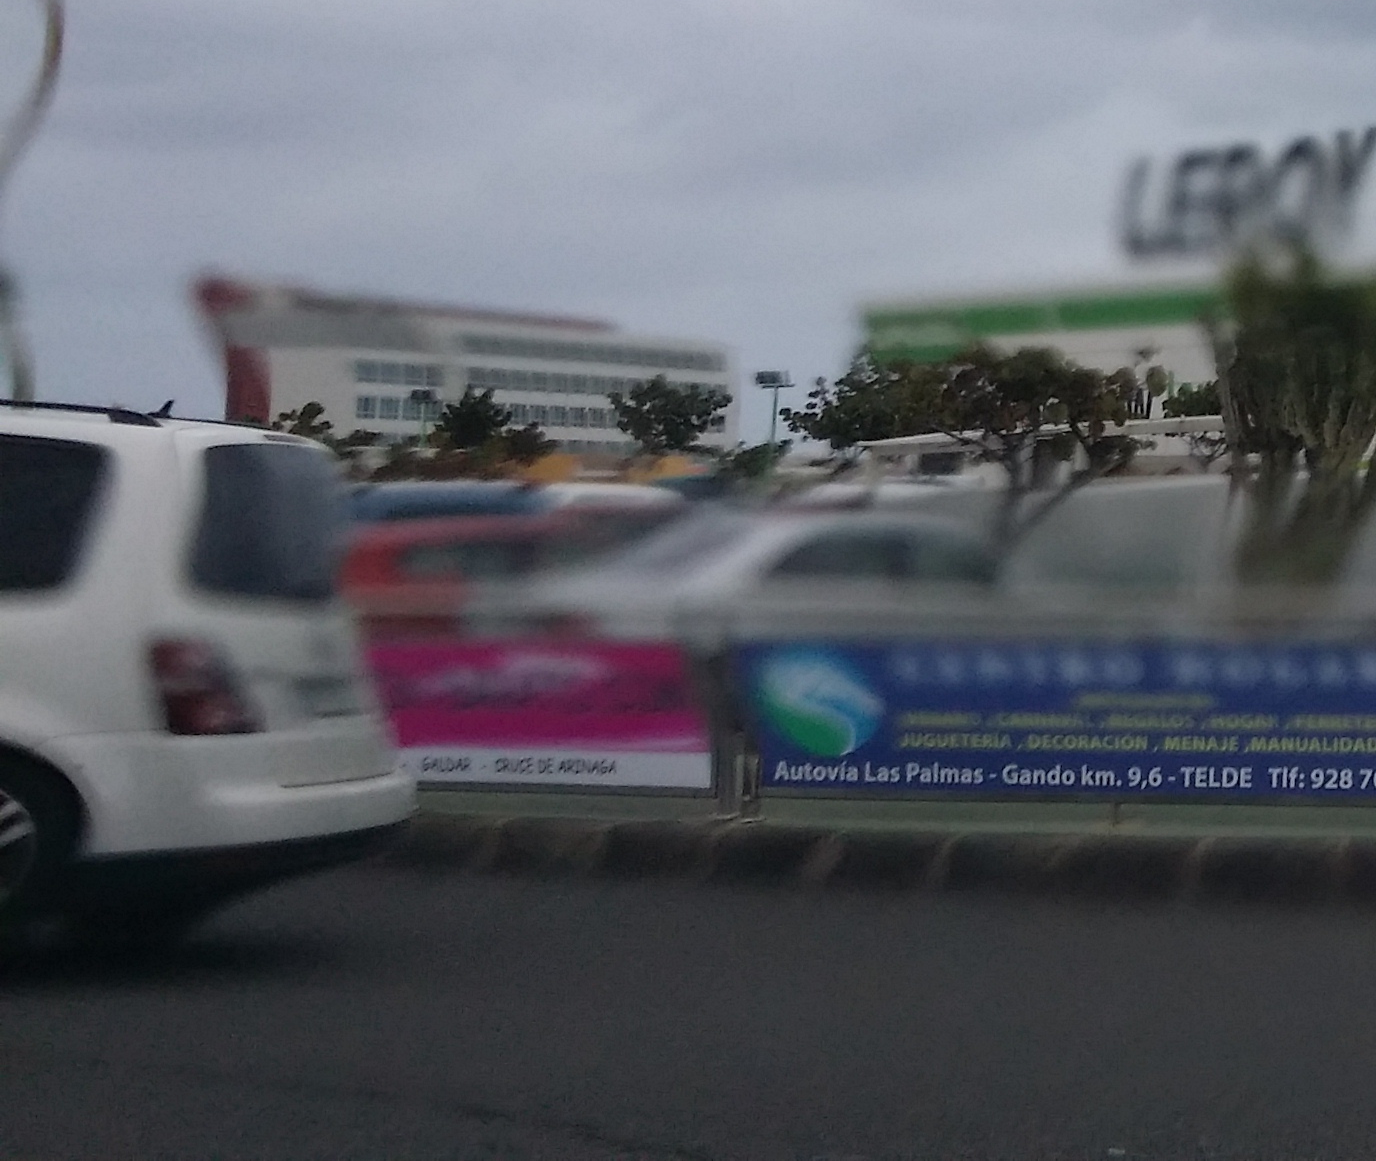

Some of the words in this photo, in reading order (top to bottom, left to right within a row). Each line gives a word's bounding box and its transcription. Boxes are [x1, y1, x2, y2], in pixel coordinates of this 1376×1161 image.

[1027, 733, 1148, 750] DECORACIÓN
[1164, 736, 1238, 752] MENAJE
[538, 757, 554, 774] DE
[559, 758, 617, 775] ARINAGA
[774, 760, 859, 783] Autovía
[865, 761, 901, 783] Las
[906, 761, 984, 784] Palmas
[1002, 763, 1076, 786] Gando
[1081, 764, 1122, 787] km.
[1128, 767, 1162, 790] 9,6
[1181, 767, 1253, 788] TELDE
[1268, 766, 1306, 788] Tlf:
[1311, 768, 1353, 789] 928
